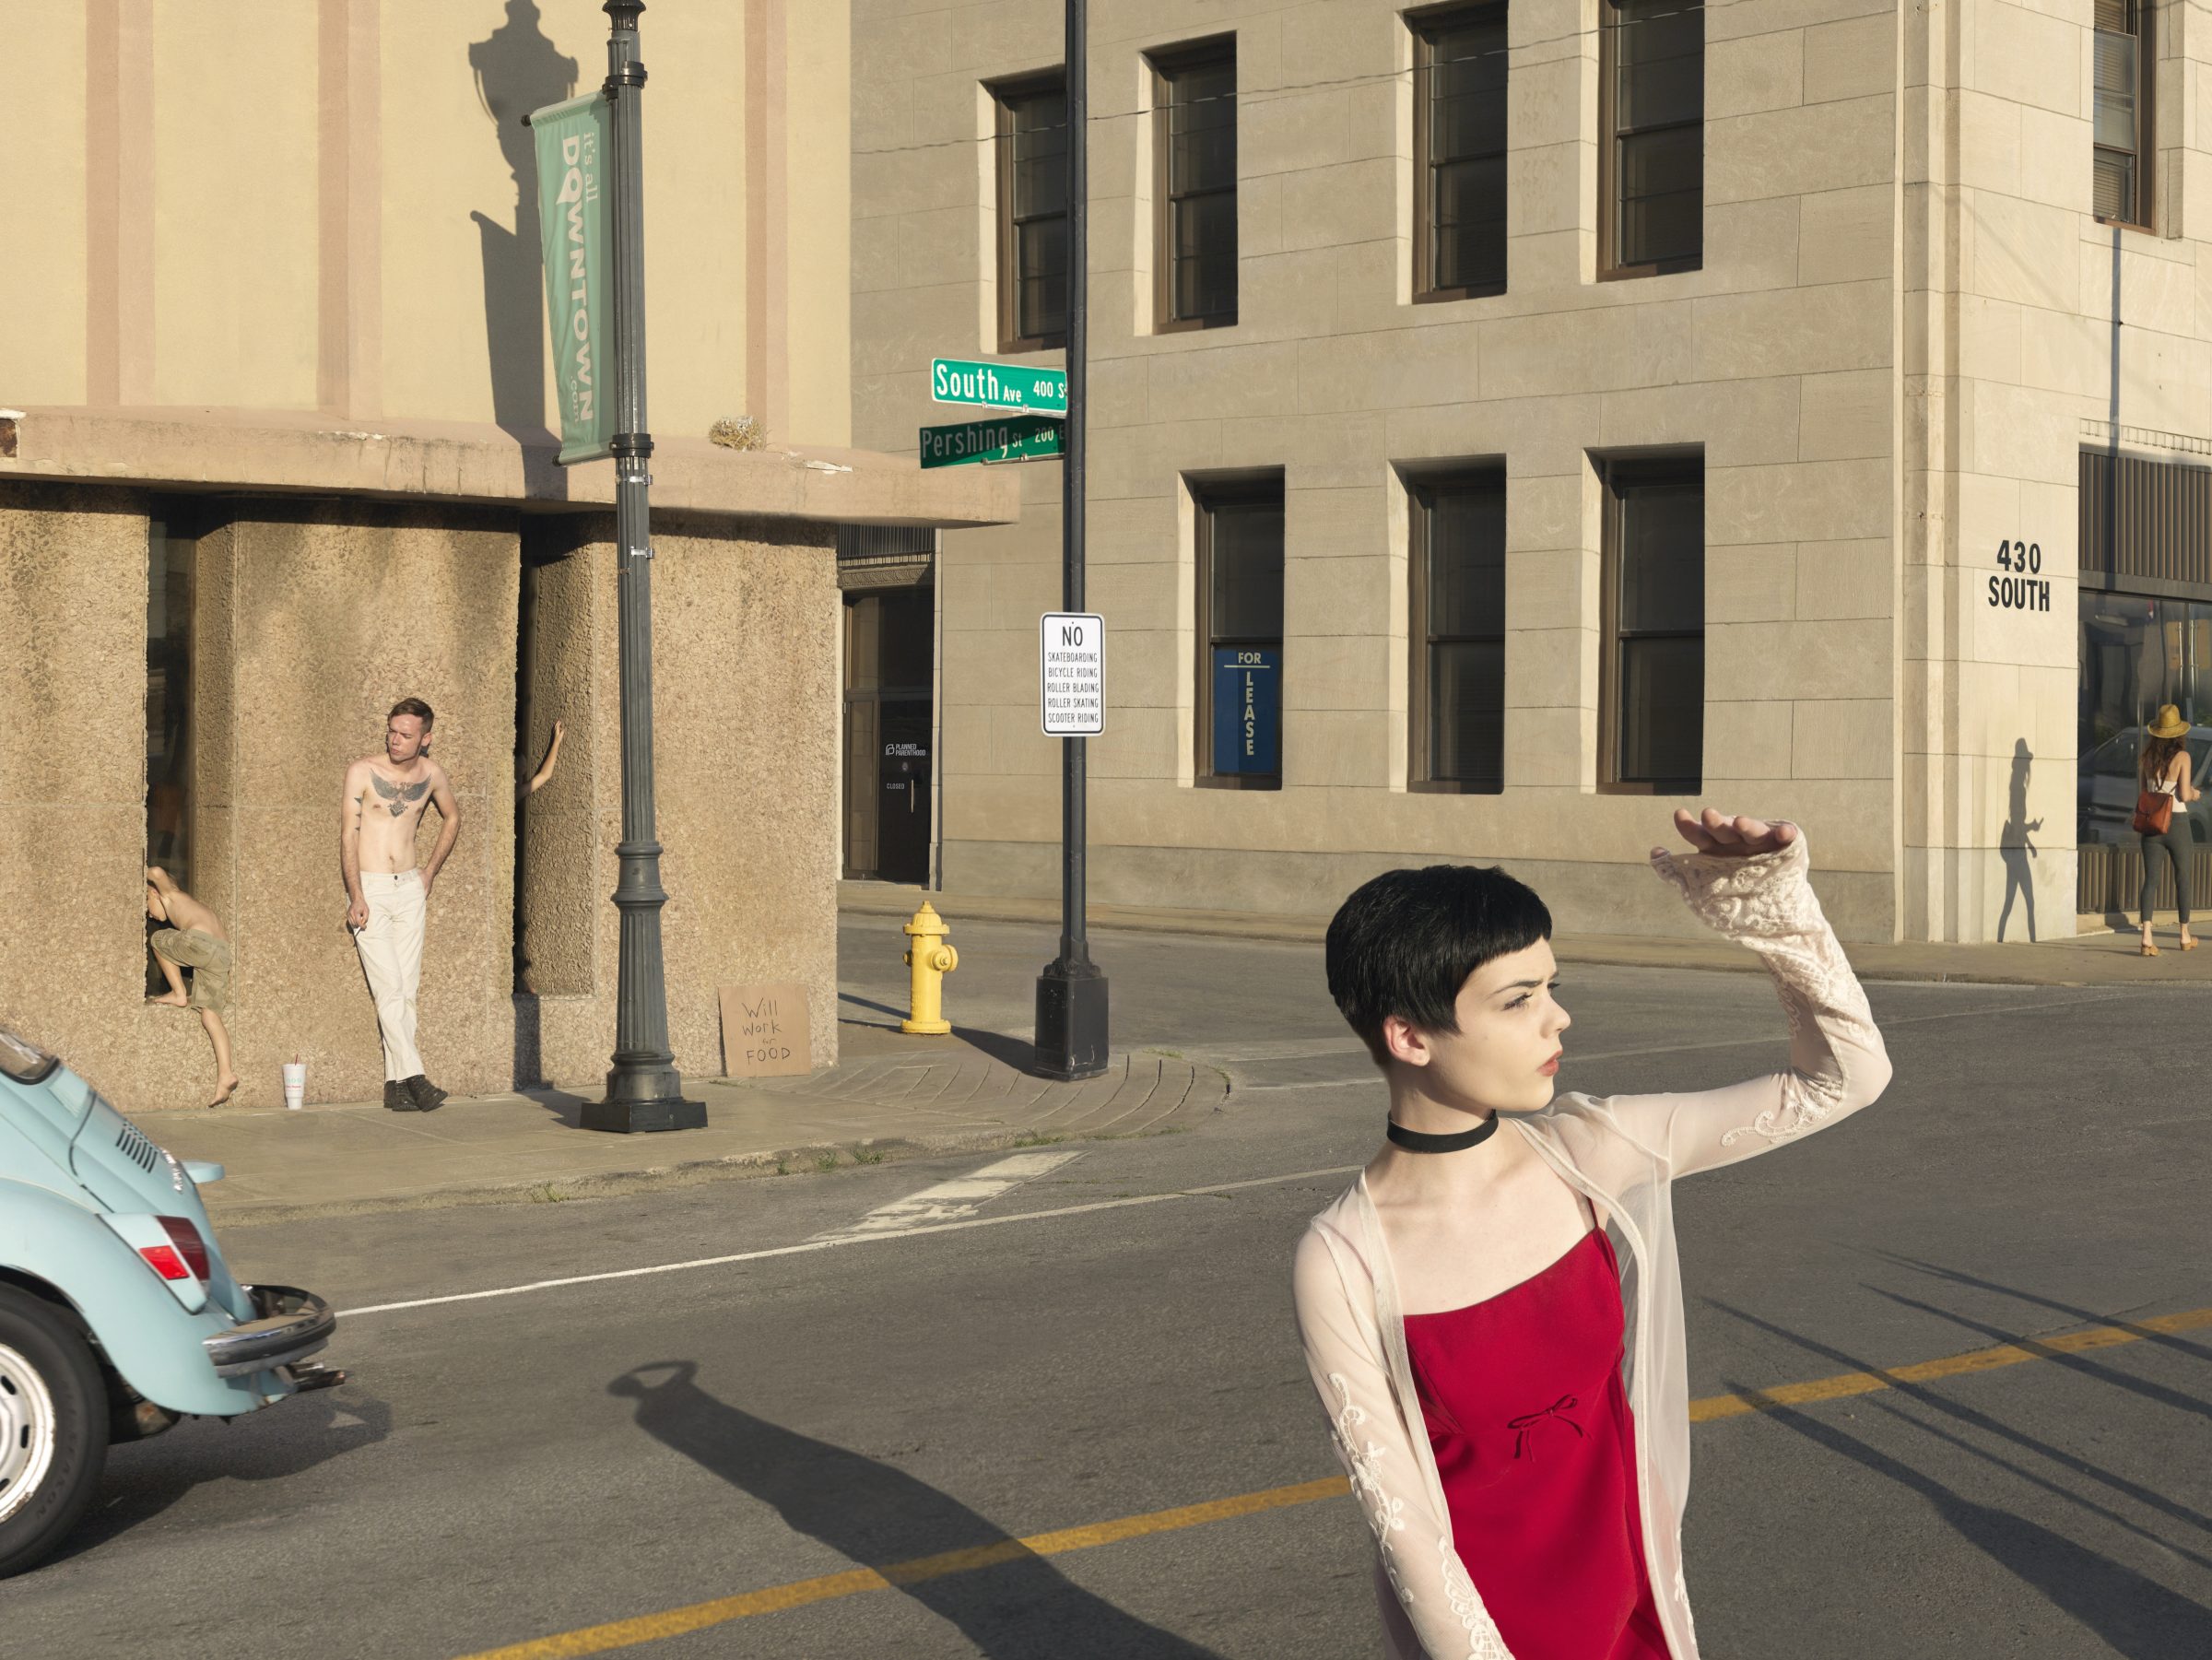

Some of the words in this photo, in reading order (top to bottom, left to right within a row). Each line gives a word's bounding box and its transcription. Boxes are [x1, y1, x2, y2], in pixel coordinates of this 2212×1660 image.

[582, 131, 595, 165] it's
[584, 173, 598, 201] all
[936, 364, 998, 400] South
[1003, 385, 1021, 403] Ave
[1033, 380, 1053, 398] 400
[922, 425, 1007, 458] Pershing
[1012, 432, 1022, 447] St
[1035, 427, 1053, 443] 200
[1997, 540, 2041, 574] 430
[1988, 576, 2050, 612] SOUTH
[1062, 626, 1083, 647] NO
[1048, 653, 1098, 663] SKATEBOARDING
[1238, 653, 1261, 664] FOR
[1049, 667, 1074, 677] BICYCLE
[1077, 668, 1098, 677] RIDING
[1047, 683, 1070, 693] ROLLER
[1073, 683, 1099, 692] BLADING
[1048, 698, 1070, 708] ROLLER
[1074, 699, 1099, 708] SKATING
[1244, 671, 1255, 756] LEASE
[1048, 713, 1075, 723] SCOOTER
[1077, 713, 1099, 723] RIDING
[742, 997, 777, 1018] Will
[747, 1048, 790, 1065] FOOD
